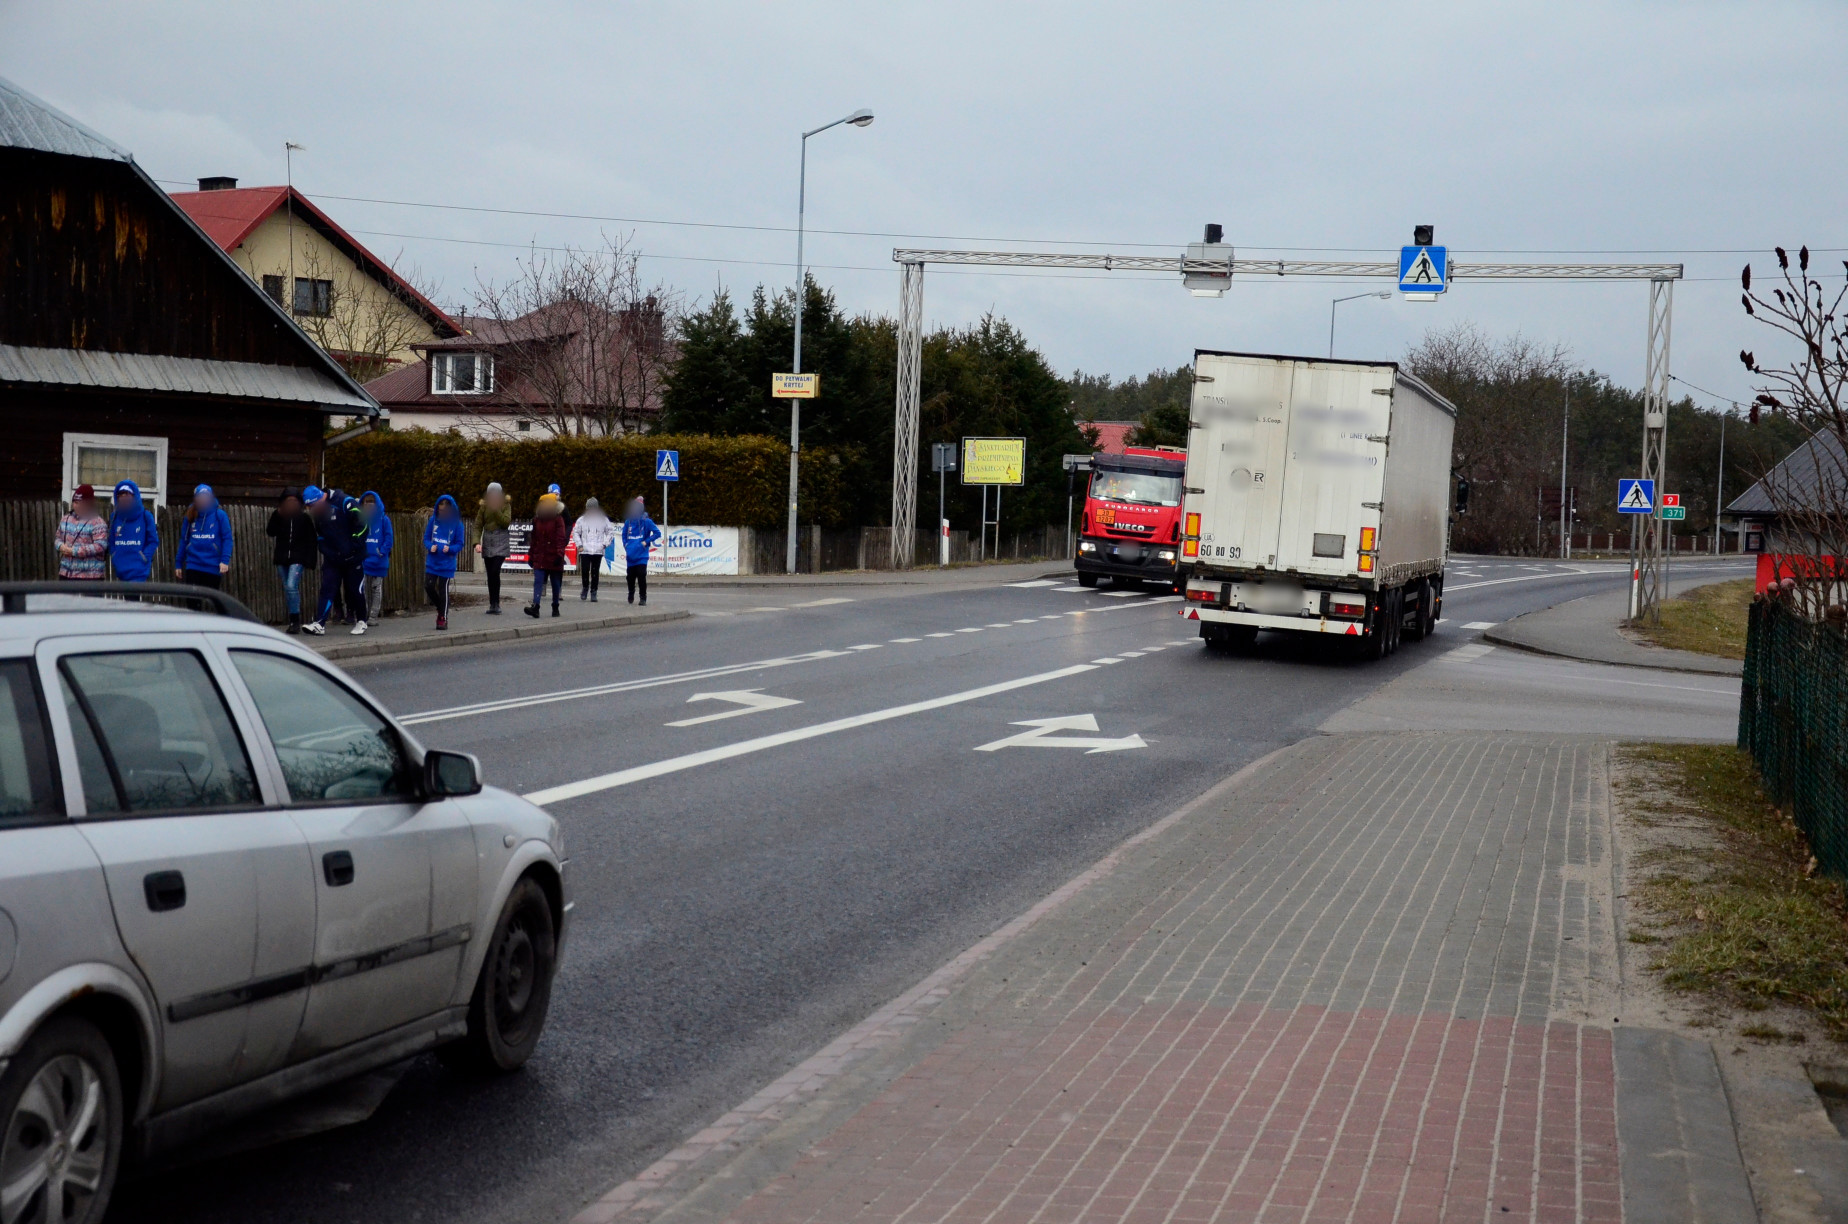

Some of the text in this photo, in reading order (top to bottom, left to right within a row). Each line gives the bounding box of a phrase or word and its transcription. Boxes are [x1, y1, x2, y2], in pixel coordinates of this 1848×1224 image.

[1106, 503, 1158, 513] EUROCARGO
[1114, 522, 1144, 532] IVECO
[668, 535, 712, 548] Klima
[1200, 544, 1212, 557] 60
[1216, 546, 1224, 557] 80
